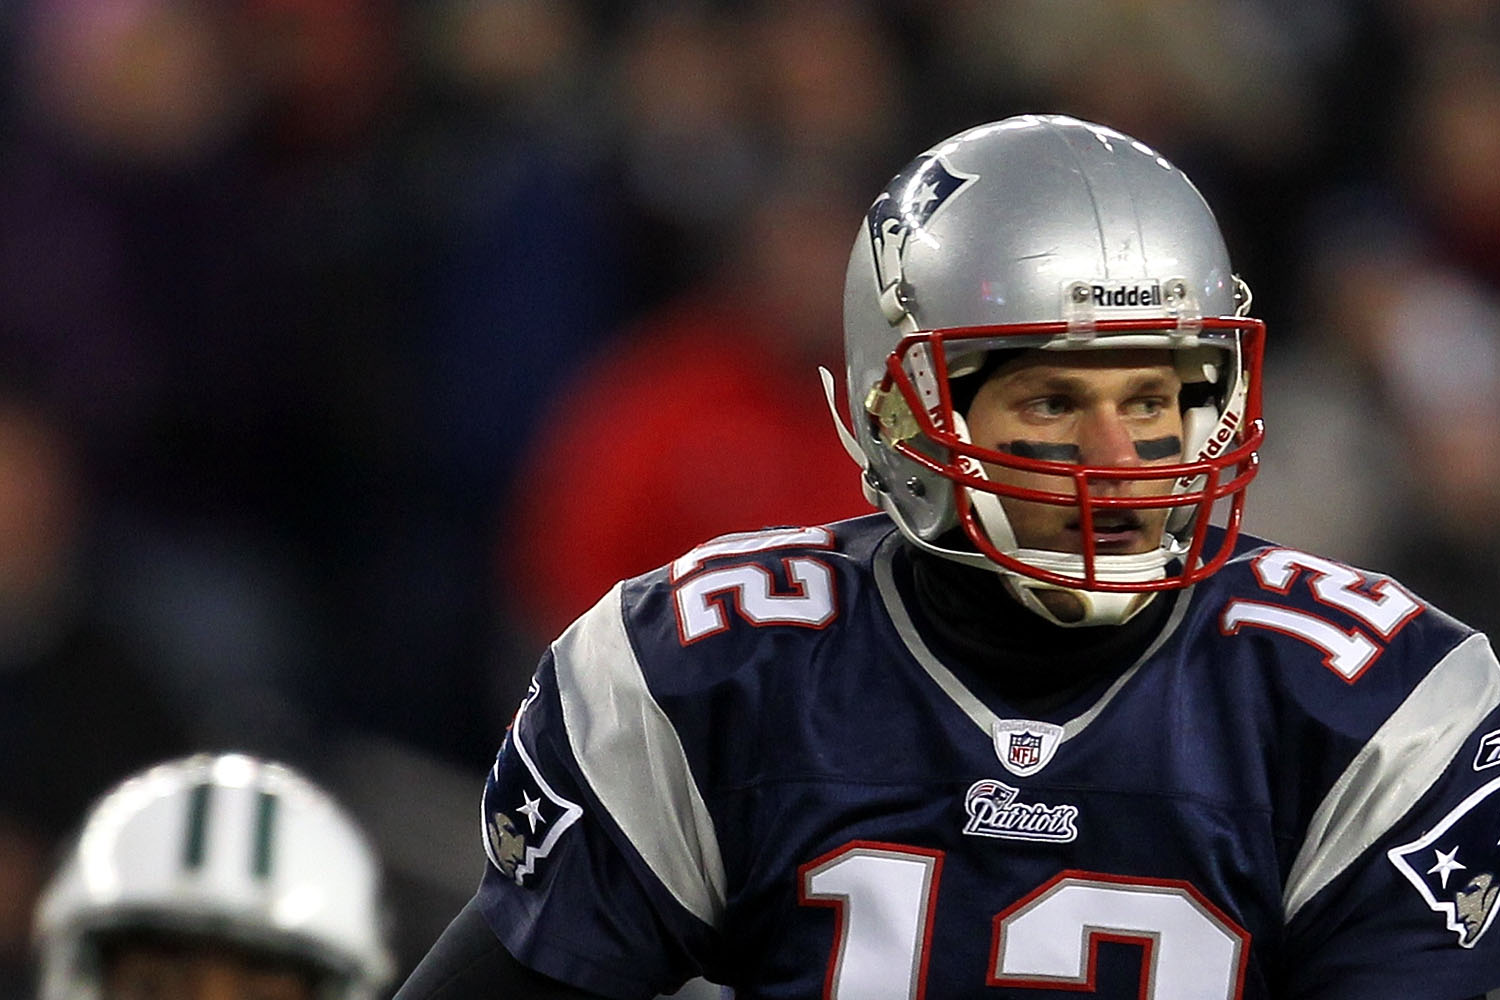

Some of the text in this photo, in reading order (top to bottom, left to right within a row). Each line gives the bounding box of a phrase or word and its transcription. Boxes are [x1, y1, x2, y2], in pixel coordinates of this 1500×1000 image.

[1091, 285, 1161, 306] Riddell
[669, 526, 840, 647] 12
[1218, 546, 1426, 685] 12
[1010, 746, 1038, 765] NFL
[970, 797, 1075, 838] Patriots
